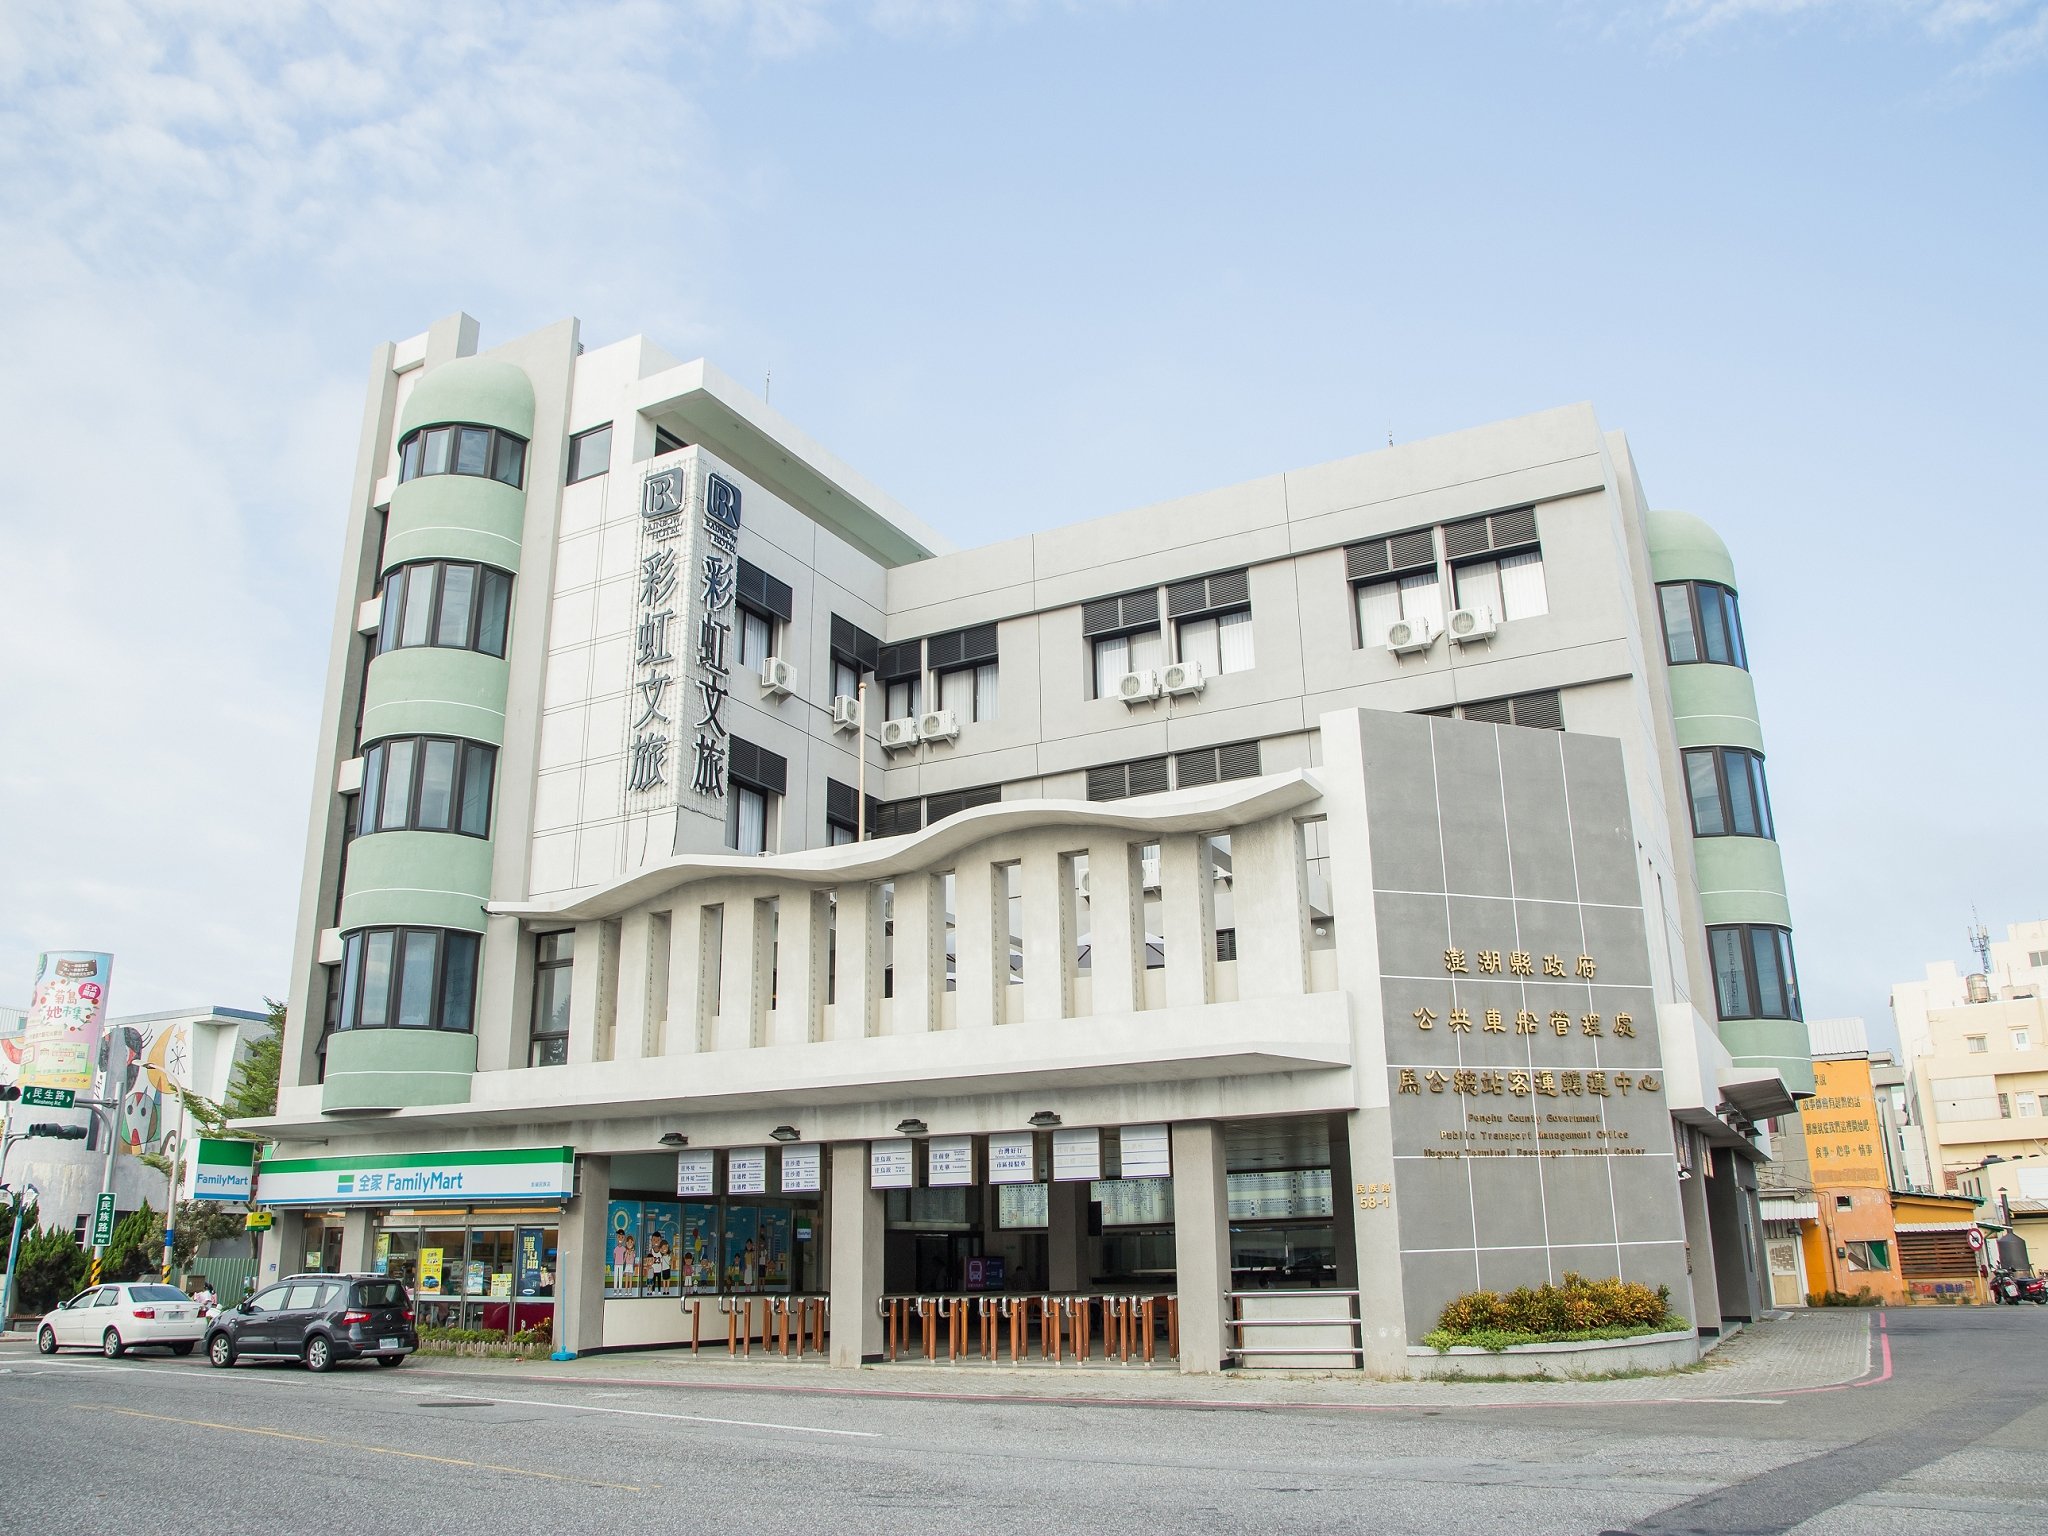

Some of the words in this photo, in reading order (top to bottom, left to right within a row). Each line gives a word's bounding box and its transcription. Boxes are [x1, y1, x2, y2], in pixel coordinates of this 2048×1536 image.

[643, 515, 683, 533] RAINBOW
[706, 519, 738, 544] RAINBOW
[652, 526, 682, 541] HOTEL
[713, 533, 737, 554] HOTEL
[628, 548, 678, 793] 彩虹文旅
[694, 555, 734, 799] 彩虹文旅
[1444, 947, 1597, 979] 澎湖縣政府
[54, 988, 78, 1004] 菊島
[1413, 1007, 1638, 1039] 公共車船管理處
[1398, 1067, 1662, 1097] 馬公總站客運轉運中心
[32, 1087, 65, 1100] 民生路
[1468, 1113, 1503, 1124] Penghu
[1508, 1113, 1541, 1125] County
[1546, 1113, 1601, 1123] Government
[1440, 1130, 1475, 1140] Public
[1480, 1131, 1532, 1141] Transport
[1538, 1130, 1591, 1141] Management
[1596, 1130, 1629, 1139] Office
[1424, 1148, 1460, 1159] Magong
[1465, 1148, 1510, 1157] Terminal
[1516, 1148, 1567, 1158] Passenger
[1572, 1147, 1608, 1156] Transit
[1614, 1147, 1646, 1156] Center
[197, 1173, 249, 1187] FamilyMart
[358, 1174, 383, 1192] 全家
[386, 1171, 464, 1193] FamilyMart
[1356, 1183, 1391, 1194] 民族路
[1360, 1196, 1390, 1209] 58-1
[97, 1201, 111, 1232] 民族路
